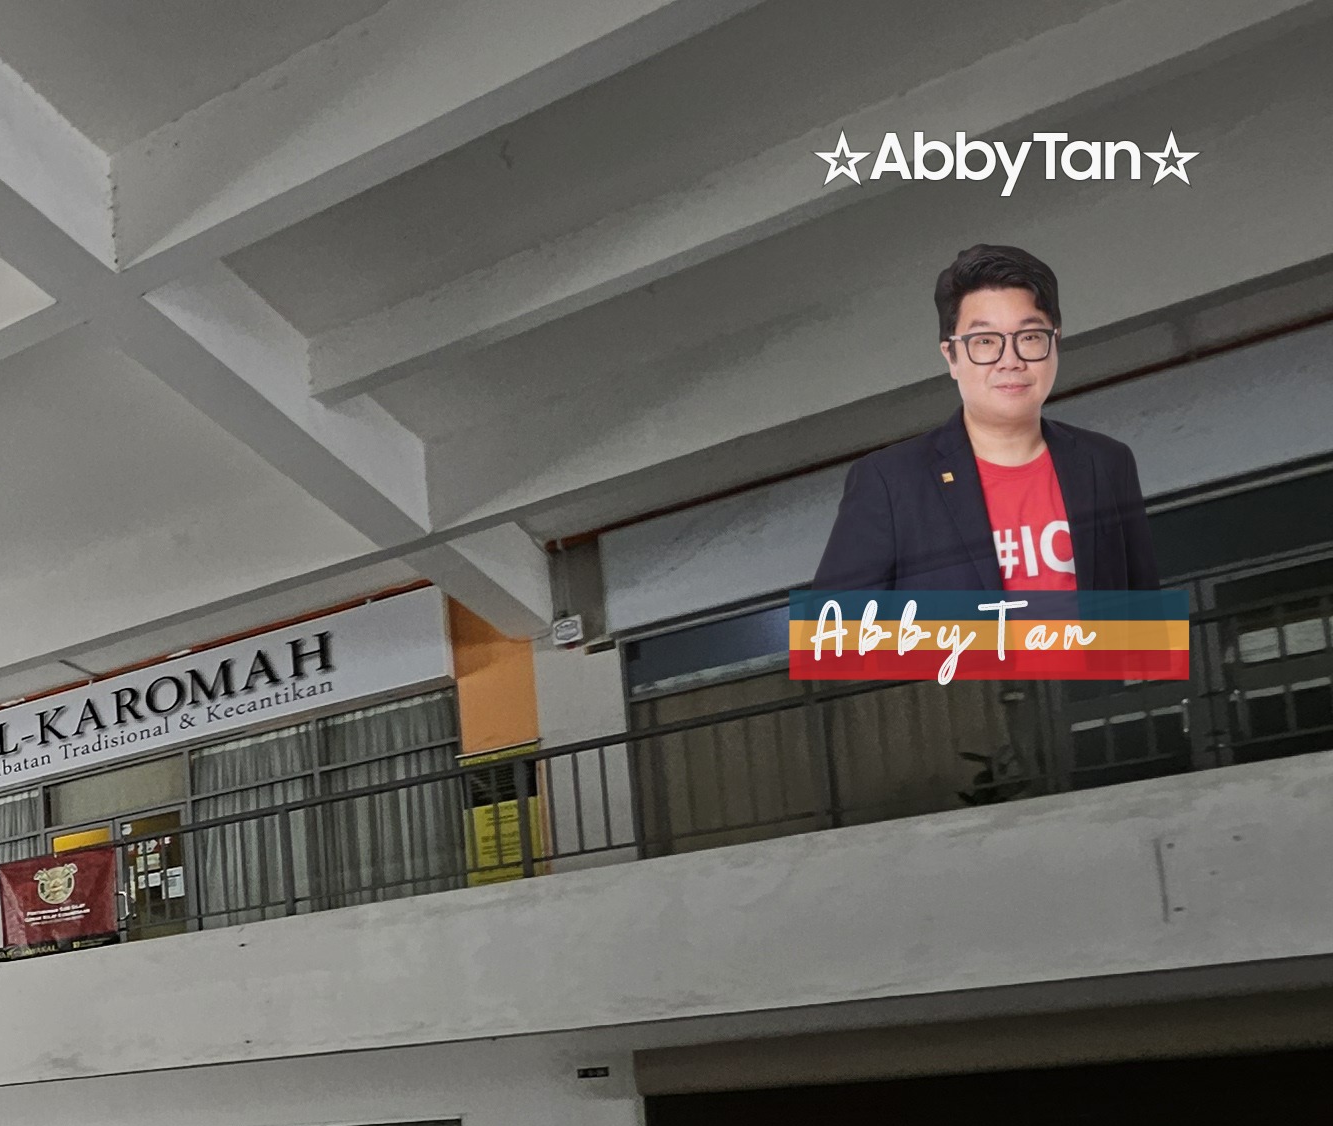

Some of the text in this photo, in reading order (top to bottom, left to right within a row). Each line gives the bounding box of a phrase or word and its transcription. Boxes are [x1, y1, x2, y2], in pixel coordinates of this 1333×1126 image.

[59, 717, 170, 760] Tradisional
[179, 713, 196, 730] &
[206, 680, 334, 723] Kecantikan
